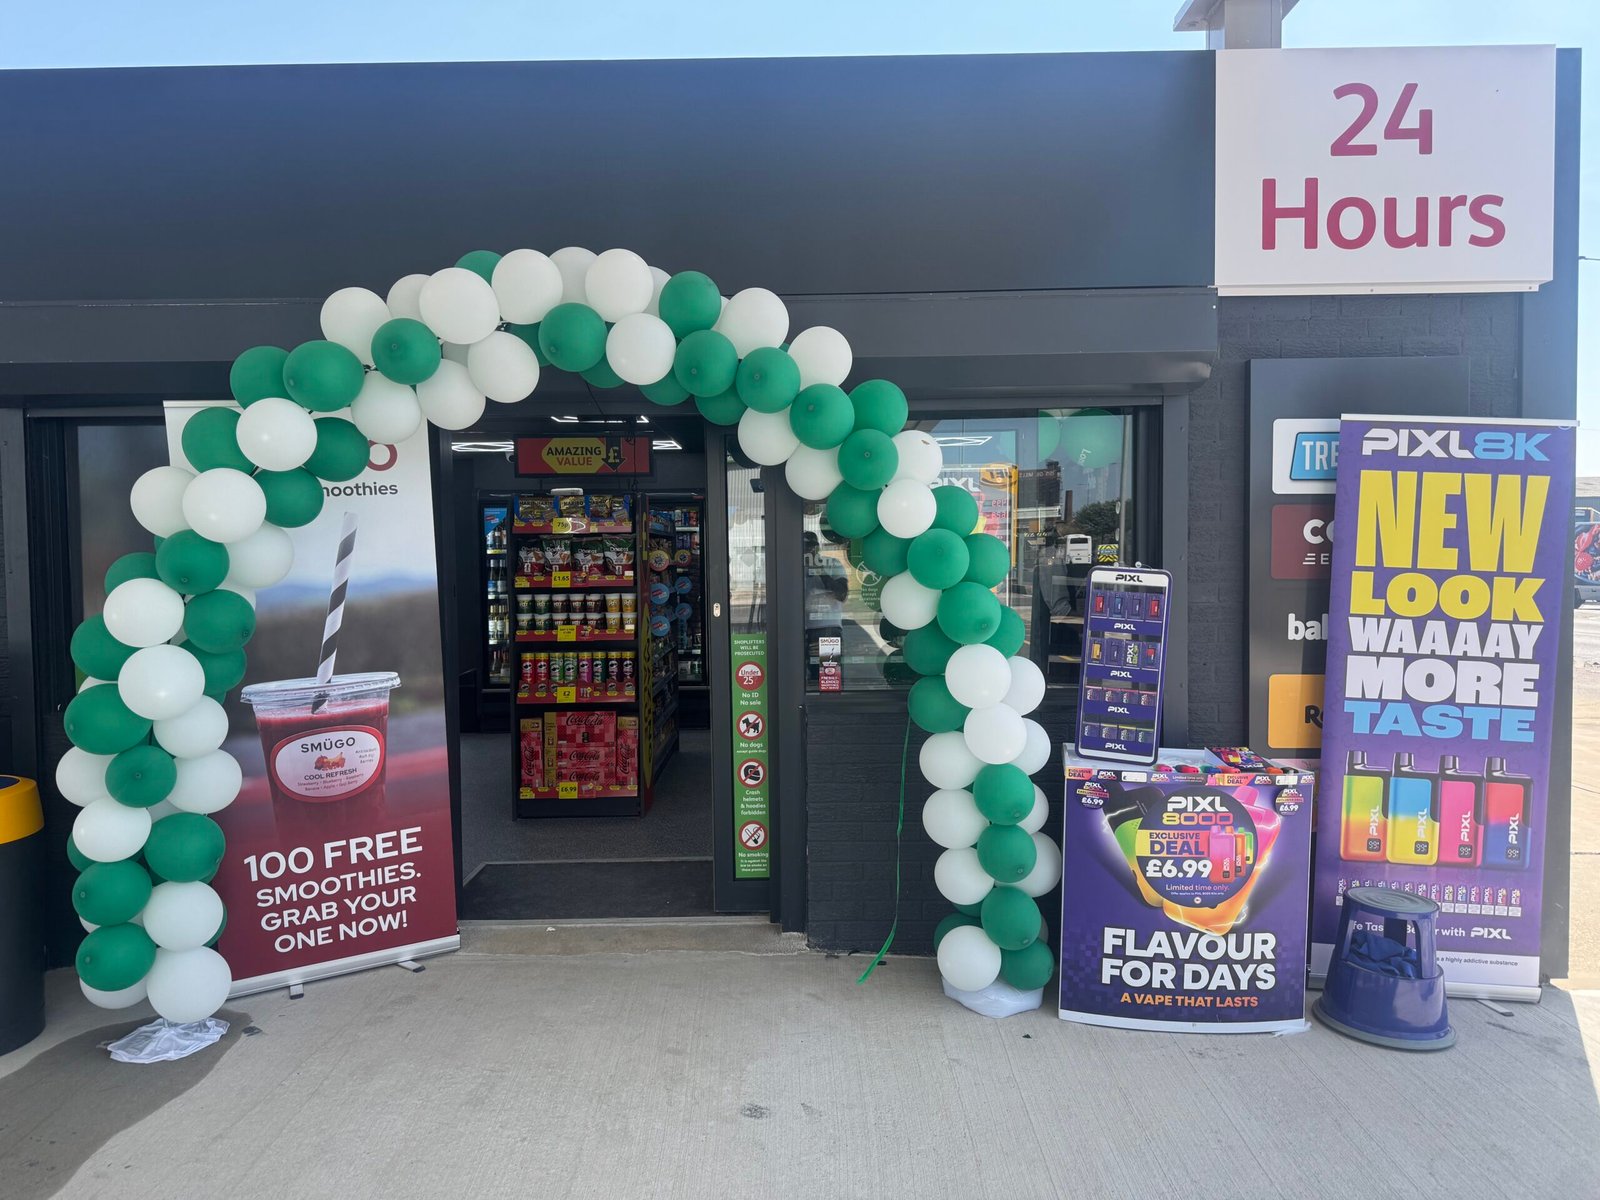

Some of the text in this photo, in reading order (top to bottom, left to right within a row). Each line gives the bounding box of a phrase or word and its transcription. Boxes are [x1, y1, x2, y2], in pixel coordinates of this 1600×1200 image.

[1330, 82, 1433, 156] 24
[1262, 177, 1506, 250] Hours
[546, 446, 601, 456] AMAZING
[556, 457, 593, 466] VALUE
[1355, 469, 1551, 573] NEW
[1115, 574, 1143, 582] PIXL
[1350, 570, 1546, 622] LOOK
[1348, 616, 1544, 659] WAAAAY
[1345, 655, 1540, 707] MORE
[1108, 706, 1130, 714] PIXL
[1305, 705, 1323, 728] R
[1344, 700, 1536, 743] TASTE
[301, 737, 355, 753] SMÜGO
[326, 768, 357, 778] REFRESH
[1162, 812, 1233, 826] 8000
[1166, 796, 1229, 812] PIXL
[1369, 805, 1379, 836] PIXL
[1417, 808, 1427, 839] PIXL
[1461, 811, 1470, 842] PIXL
[1508, 813, 1519, 844] PIXL
[243, 826, 423, 882] 100 FREE
[1150, 841, 1204, 855] DEAL
[1146, 859, 1212, 878] £6.99
[256, 861, 422, 908] SMOOTHIES.
[260, 886, 416, 931] GRAB YOUR
[274, 910, 407, 952] ONE NOW!
[1103, 926, 1276, 961] FLAVOUR
[1441, 927, 1466, 937] with
[1470, 927, 1512, 940] PIXL
[1102, 957, 1276, 991] FOR DAYS
[1120, 993, 1259, 1008] A VAPE THAT LASTS
